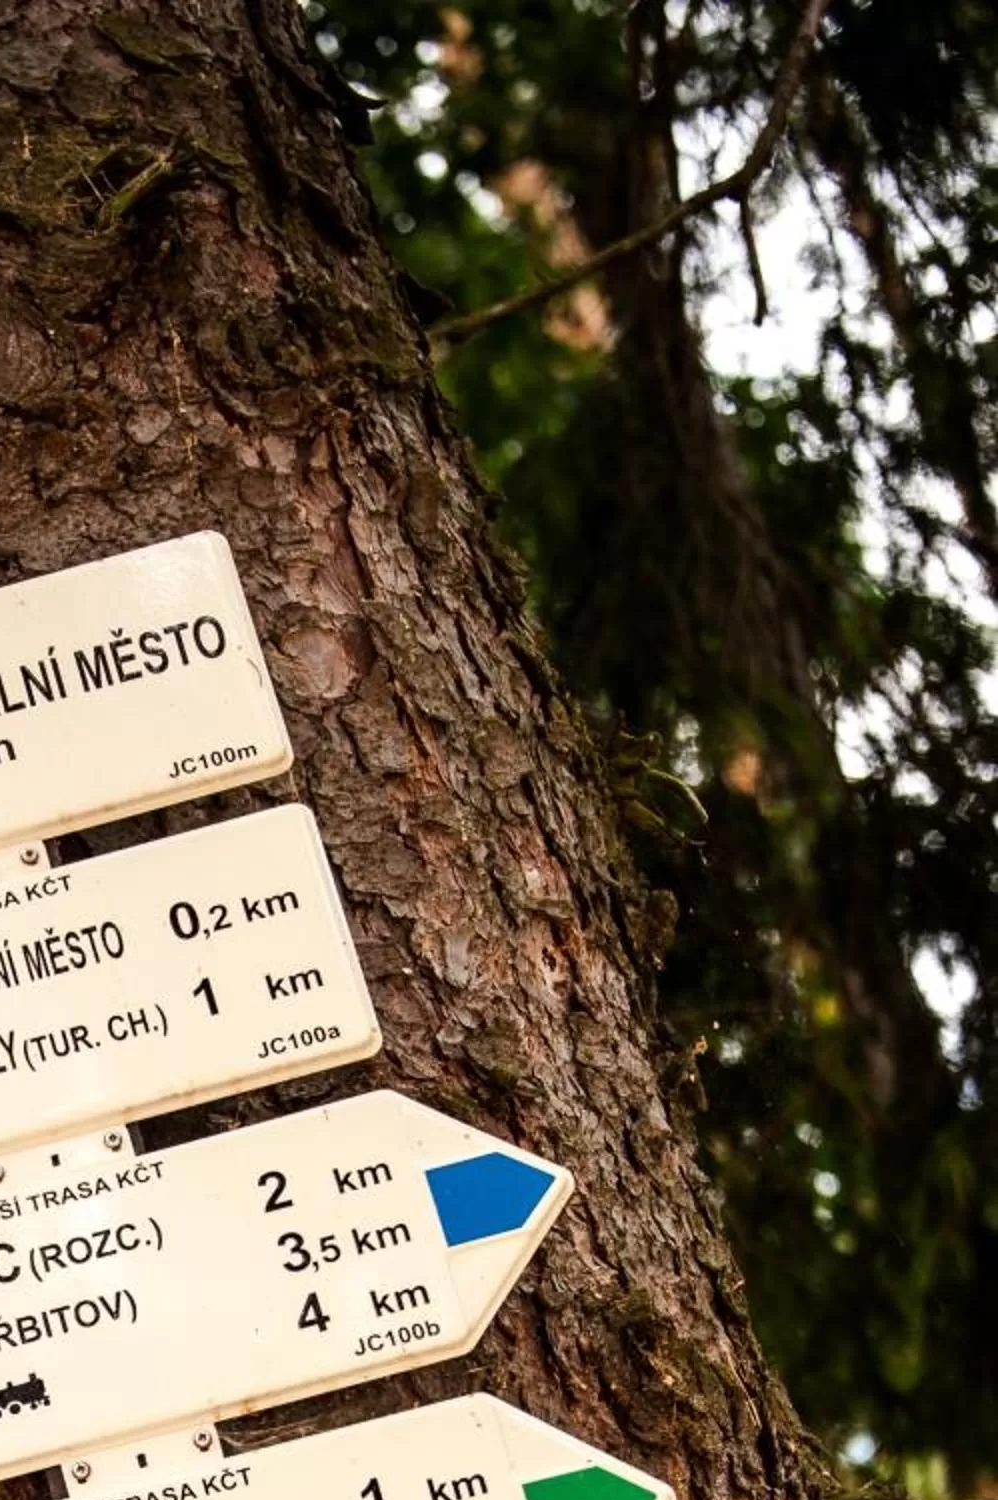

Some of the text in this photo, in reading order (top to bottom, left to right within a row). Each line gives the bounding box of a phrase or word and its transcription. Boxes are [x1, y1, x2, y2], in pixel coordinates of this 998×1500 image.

[73, 615, 227, 693] MĚSTO
[169, 745, 258, 779] JC100m
[24, 874, 71, 902] KČT
[169, 891, 299, 941] 0,2 km
[21, 921, 125, 982] MĚSTO
[192, 968, 324, 1017] 1 km
[23, 1024, 101, 1073] (TUR.
[107, 1004, 168, 1041] CH.)
[257, 1026, 341, 1059] JC100a
[26, 1177, 112, 1212] TRASA
[115, 1161, 163, 1189] KČT
[257, 1162, 393, 1214] 2 km
[29, 1217, 163, 1283] (ROZC.)
[277, 1223, 411, 1273] 3,5 km
[297, 1285, 431, 1333] 4 km
[354, 1320, 441, 1357] JC100b
[201, 1467, 251, 1496] KČT
